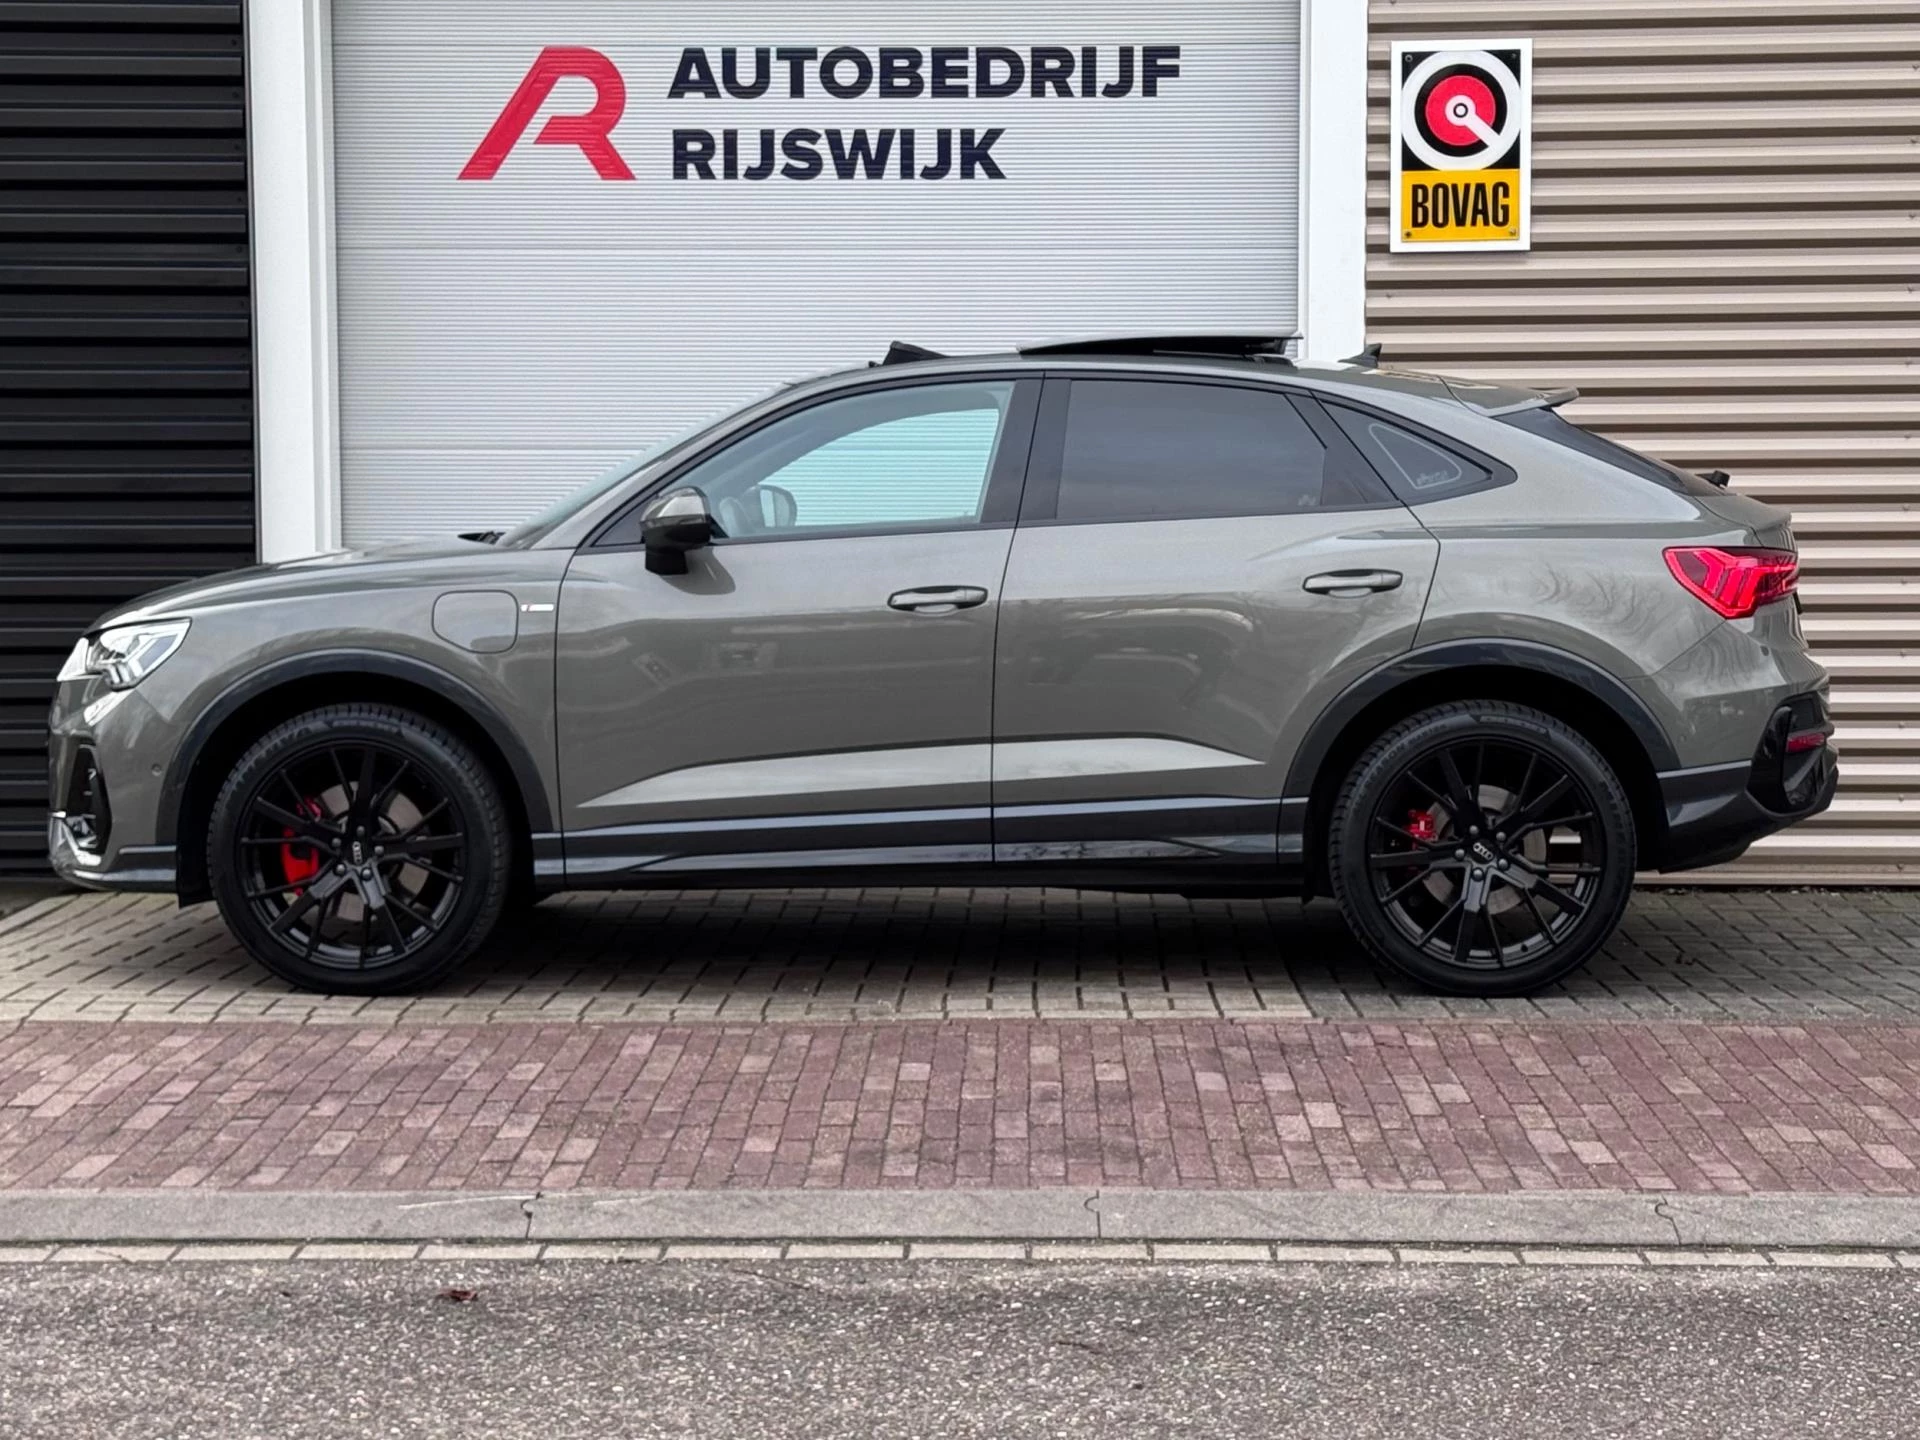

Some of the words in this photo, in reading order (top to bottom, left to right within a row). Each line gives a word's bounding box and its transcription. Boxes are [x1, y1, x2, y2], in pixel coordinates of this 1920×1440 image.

[667, 45, 1181, 100] AUTOBEDRIJF
[672, 128, 1007, 181] RIJSWIJK
[1411, 181, 1510, 229] BOVAG
